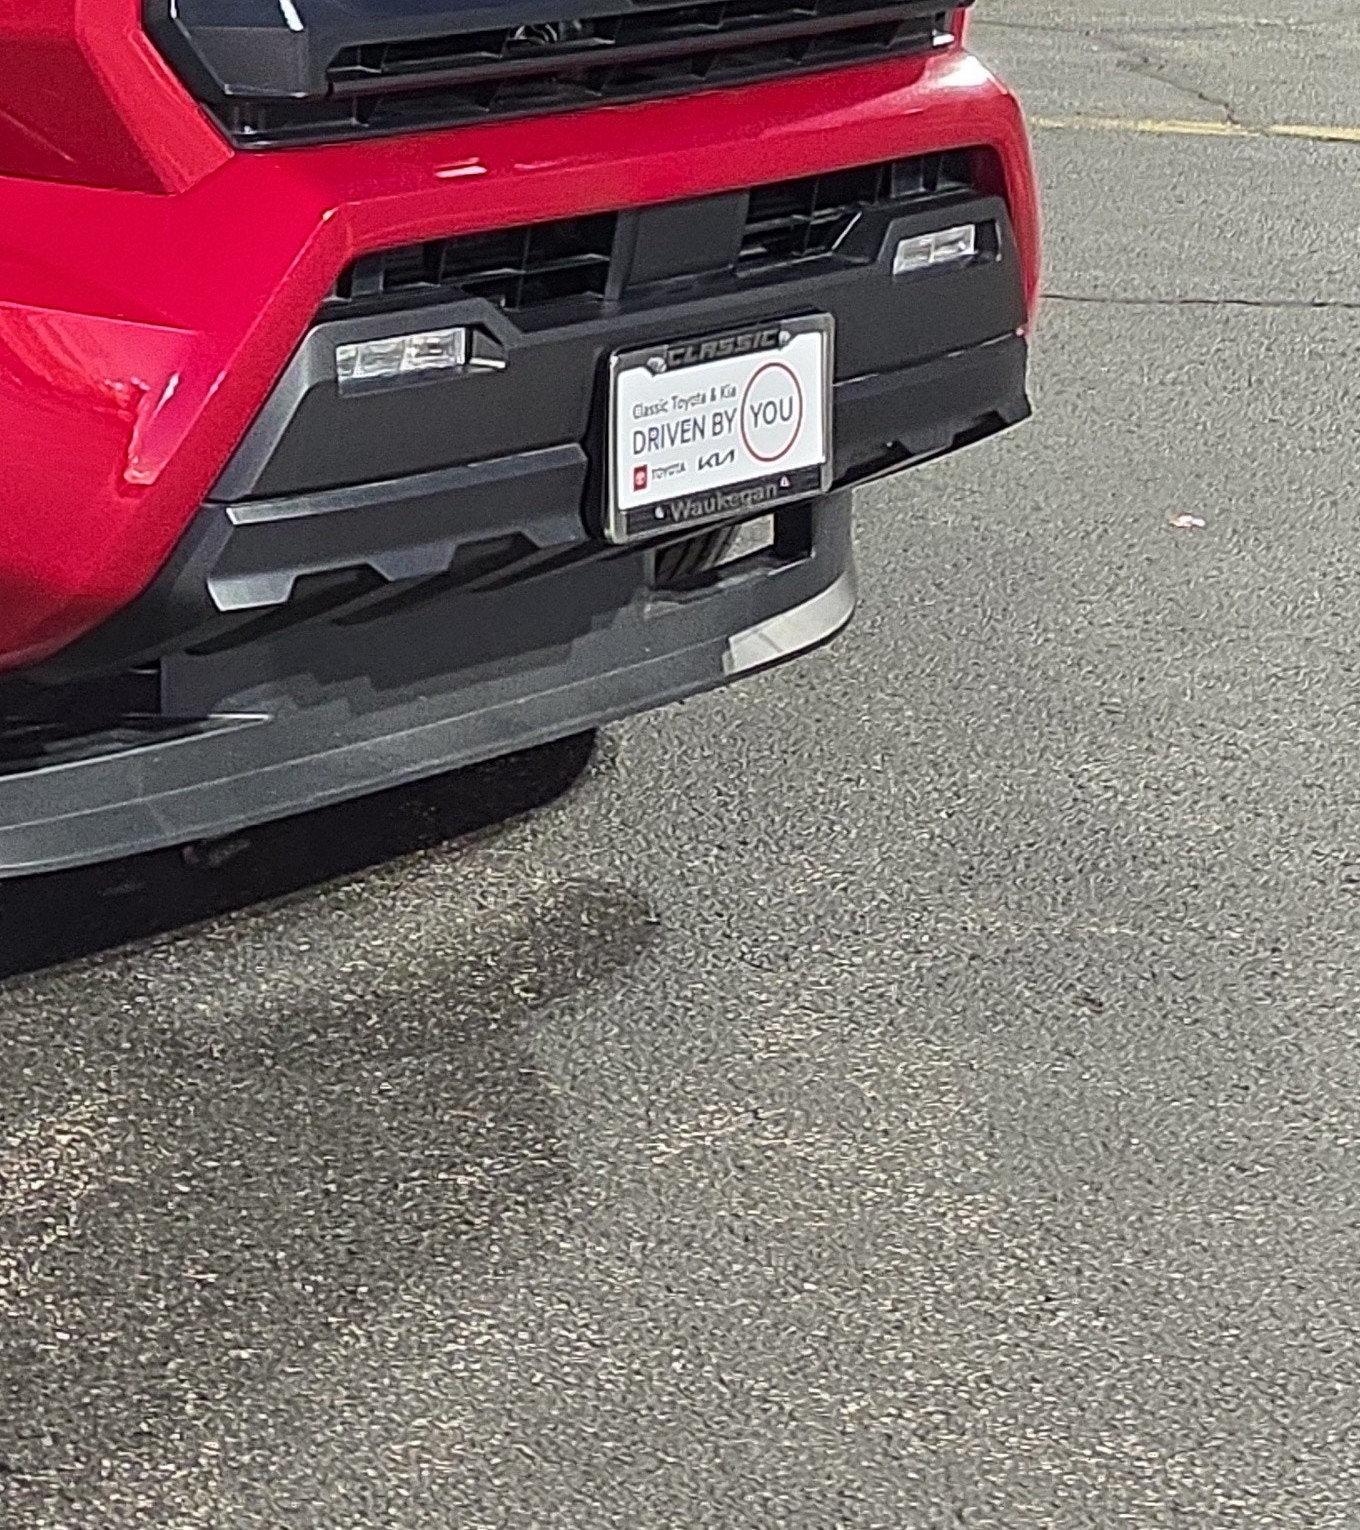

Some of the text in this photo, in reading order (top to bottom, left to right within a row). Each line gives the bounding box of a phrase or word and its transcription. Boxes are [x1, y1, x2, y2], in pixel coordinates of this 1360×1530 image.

[668, 331, 778, 365] CLASSIC
[633, 382, 737, 419] Classic Toyota & Kia
[633, 396, 794, 455] DRIVEN BY YOU
[651, 462, 686, 480] TOYOTA
[670, 484, 777, 521] Waukegan
